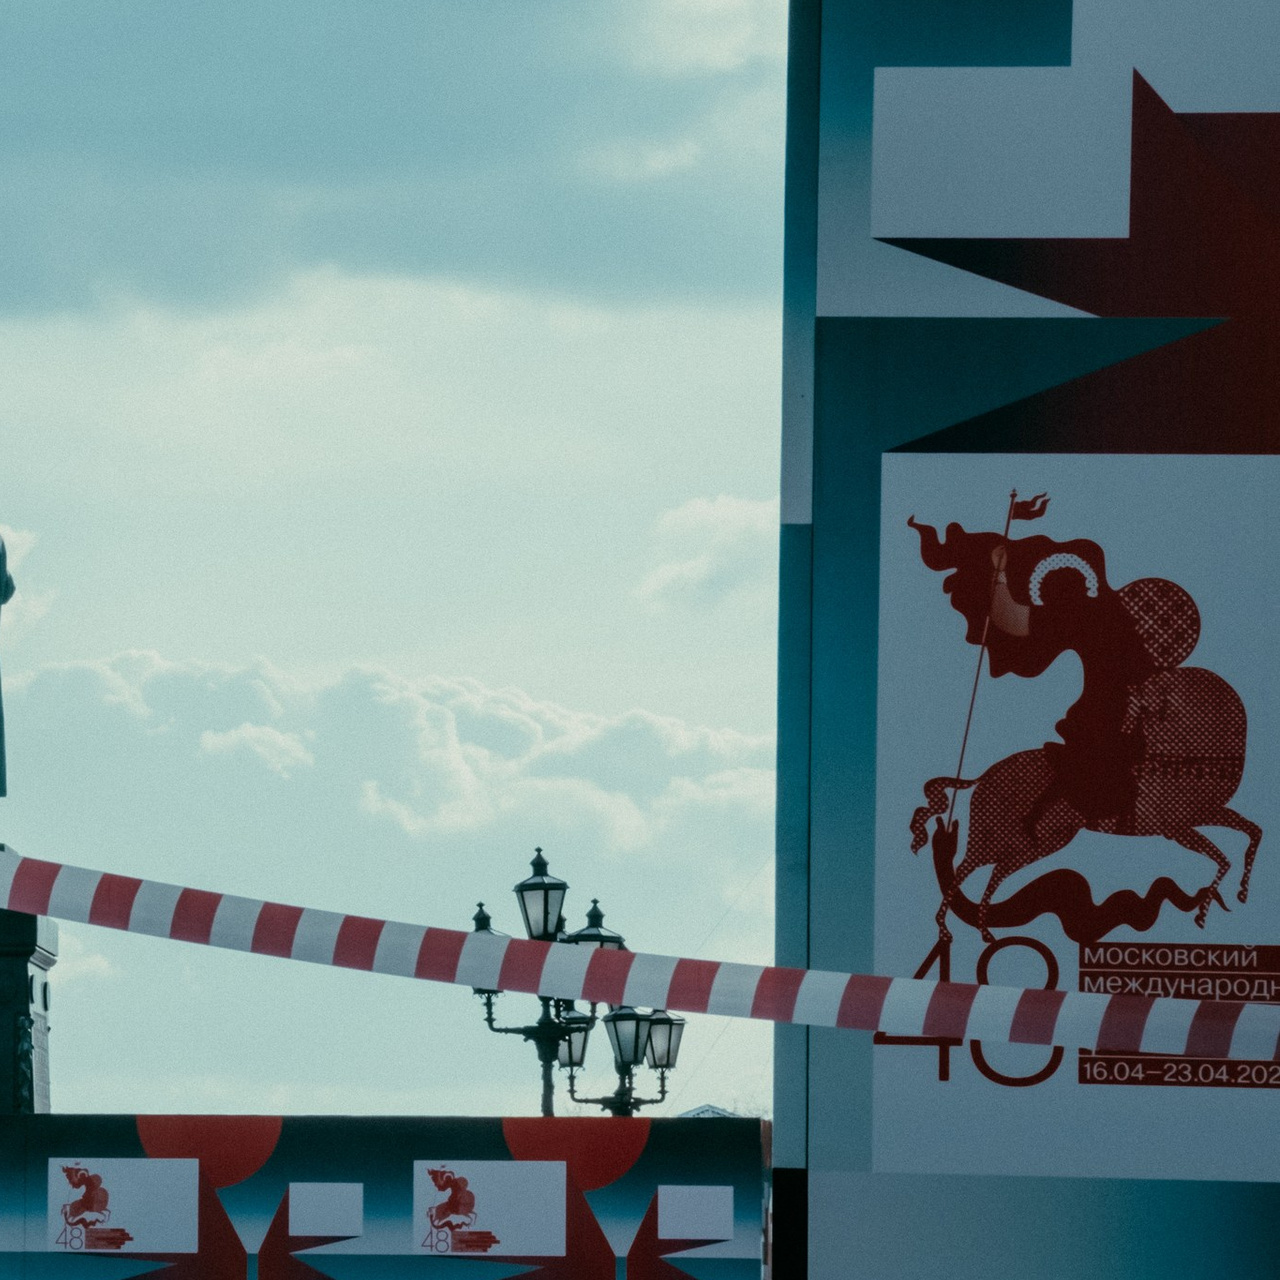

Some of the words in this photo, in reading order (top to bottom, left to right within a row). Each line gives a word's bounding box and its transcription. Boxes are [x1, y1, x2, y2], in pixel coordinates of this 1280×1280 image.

[1084, 945, 1259, 967] московский
[55, 1227, 83, 1250] 48
[421, 1230, 450, 1253] 48
